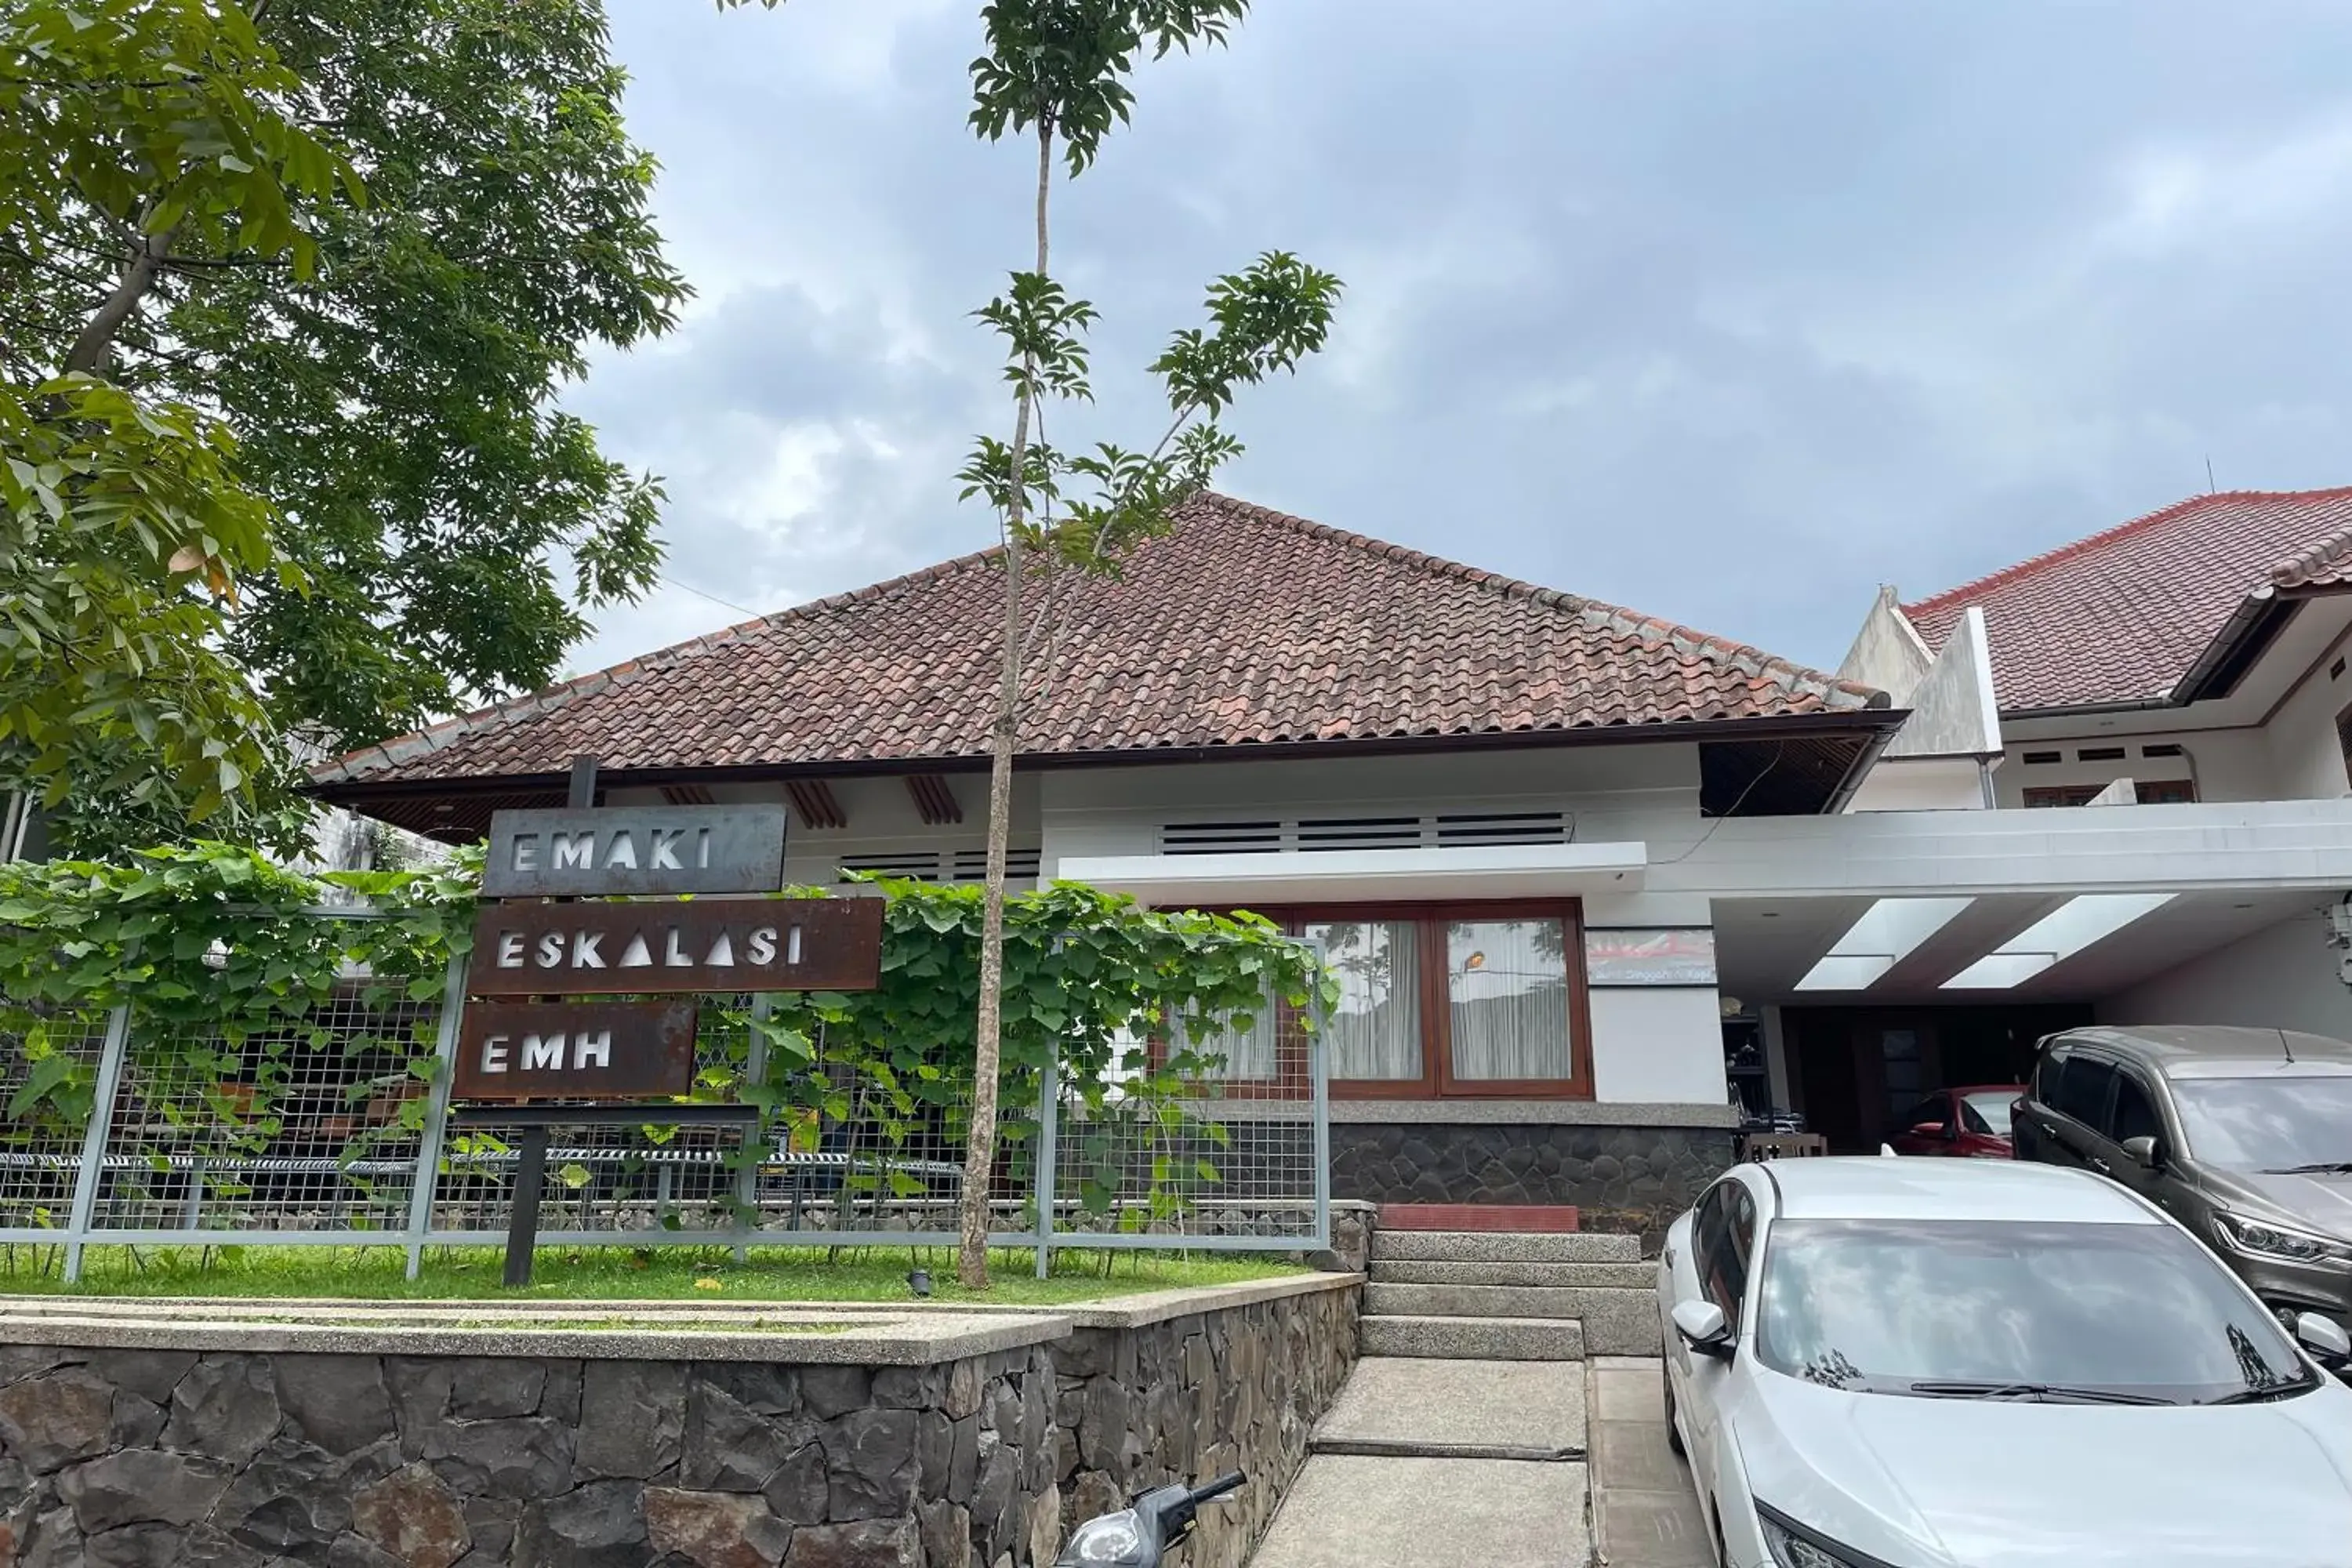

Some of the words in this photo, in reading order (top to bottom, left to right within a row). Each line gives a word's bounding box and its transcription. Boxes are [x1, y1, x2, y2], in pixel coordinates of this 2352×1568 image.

[513, 827, 710, 871] EMAKI
[496, 924, 801, 969] ESKALASI
[480, 1030, 612, 1074] EMH
